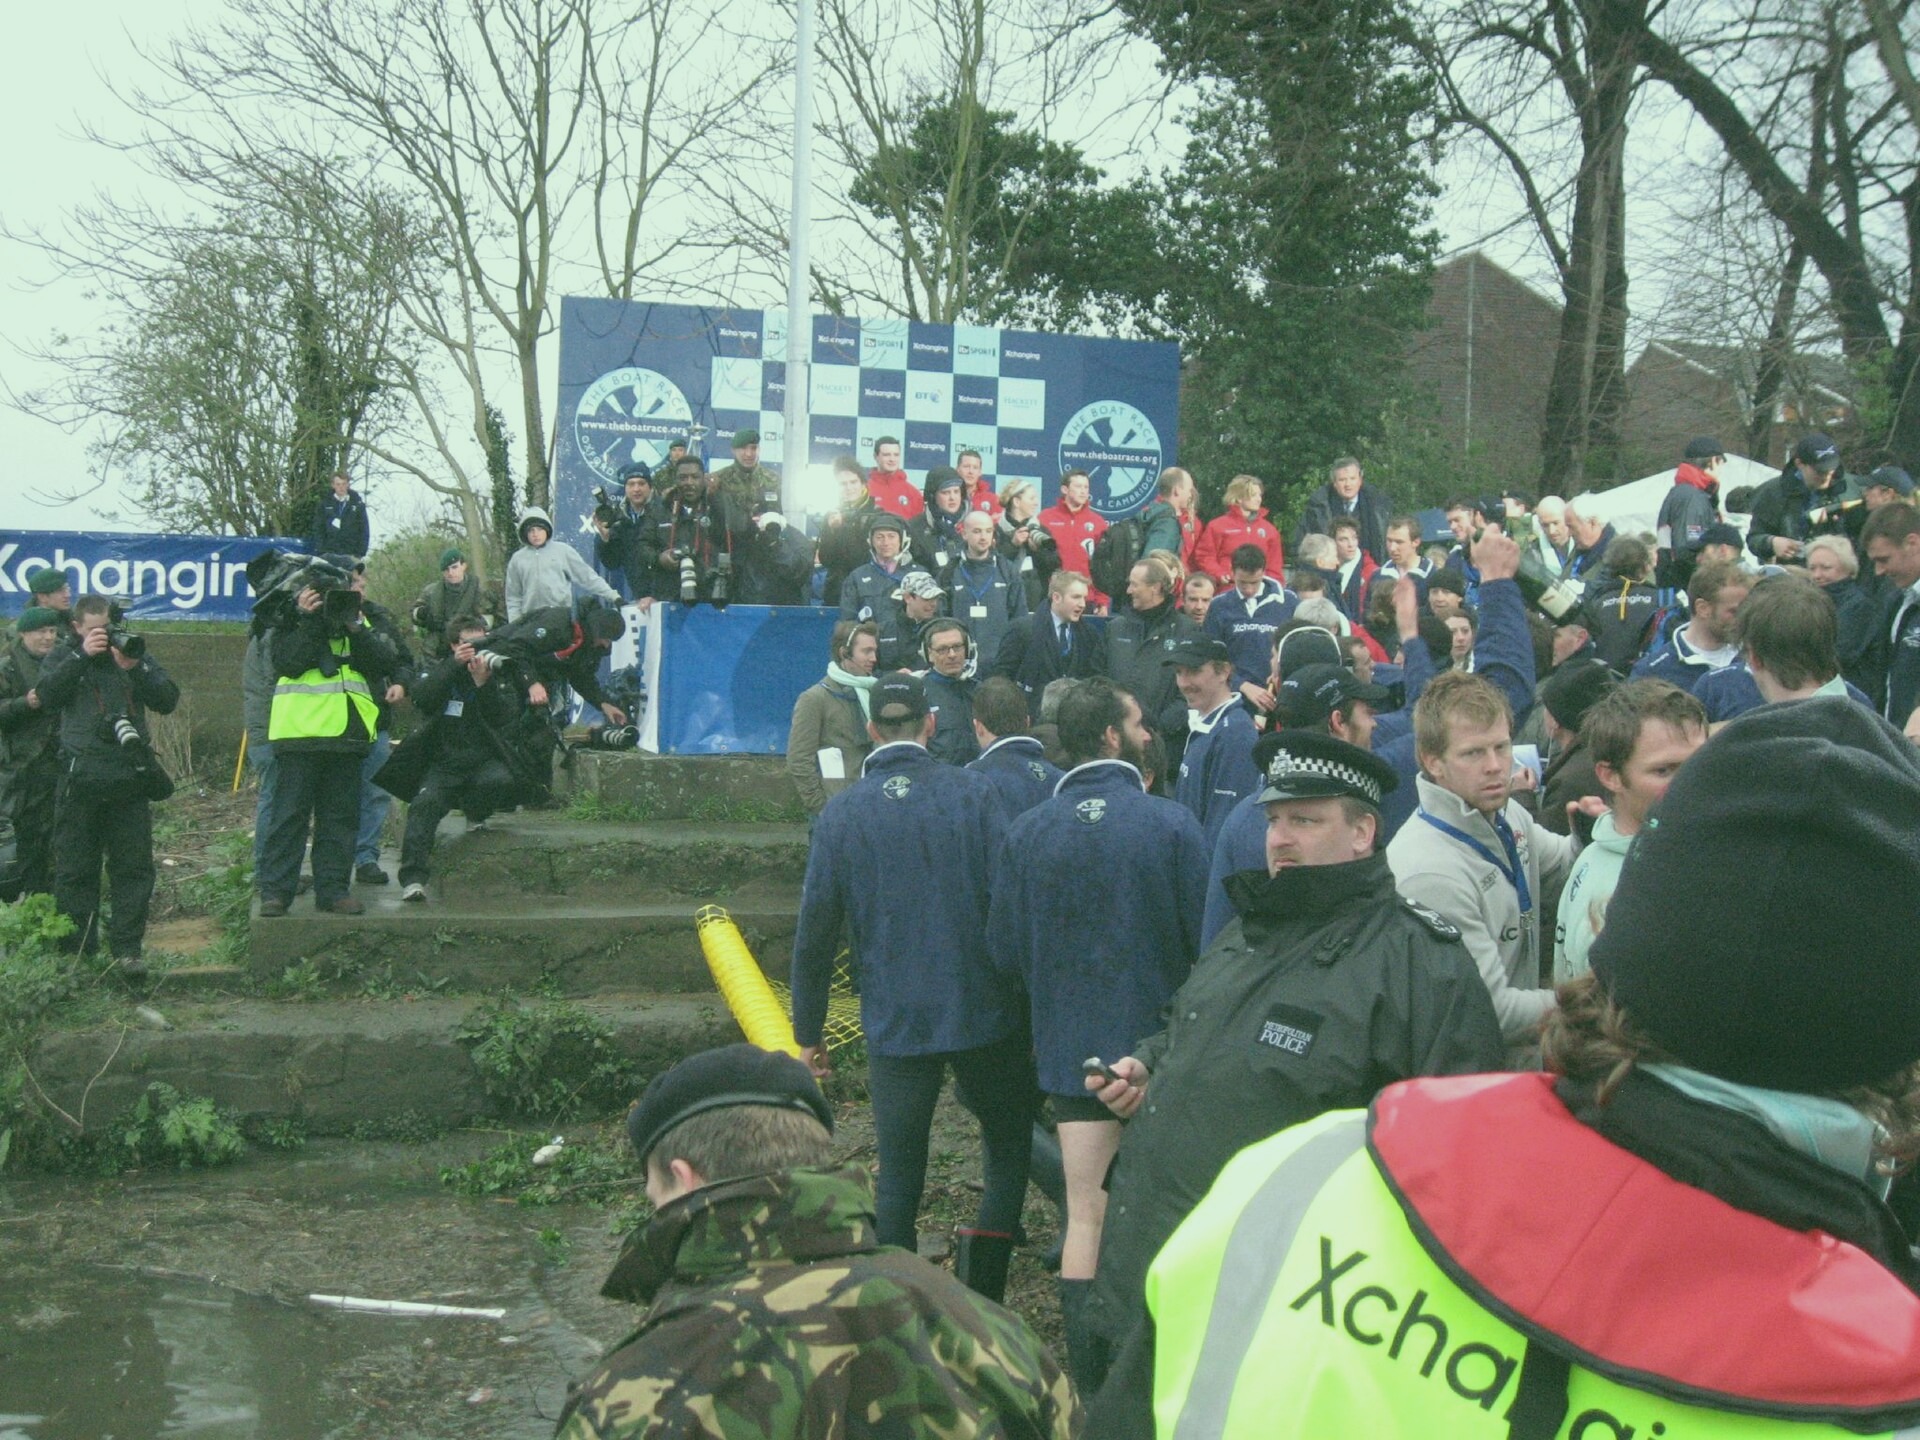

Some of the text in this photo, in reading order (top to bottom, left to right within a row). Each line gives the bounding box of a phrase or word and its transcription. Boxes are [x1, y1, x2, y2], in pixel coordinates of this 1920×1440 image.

[913, 342, 949, 353] Xchanging
[1005, 349, 1040, 360] Xchanging
[584, 373, 685, 415] THE BOAT RACE
[864, 388, 901, 399] Xchanging
[958, 394, 994, 406] Xchanging
[581, 420, 688, 437] www.theboatrace.org
[1067, 405, 1155, 444] THE BOAT RACE
[814, 435, 851, 446] Xchanging
[909, 441, 945, 452] Xchanging
[1002, 447, 1037, 458] Xchanging
[1063, 450, 1158, 465] www.theboatrace.org
[1107, 468, 1156, 508] CAMBRIDGE
[1264, 1020, 1313, 1042] METROPOLITAN
[1259, 1028, 1307, 1055] POLICE
